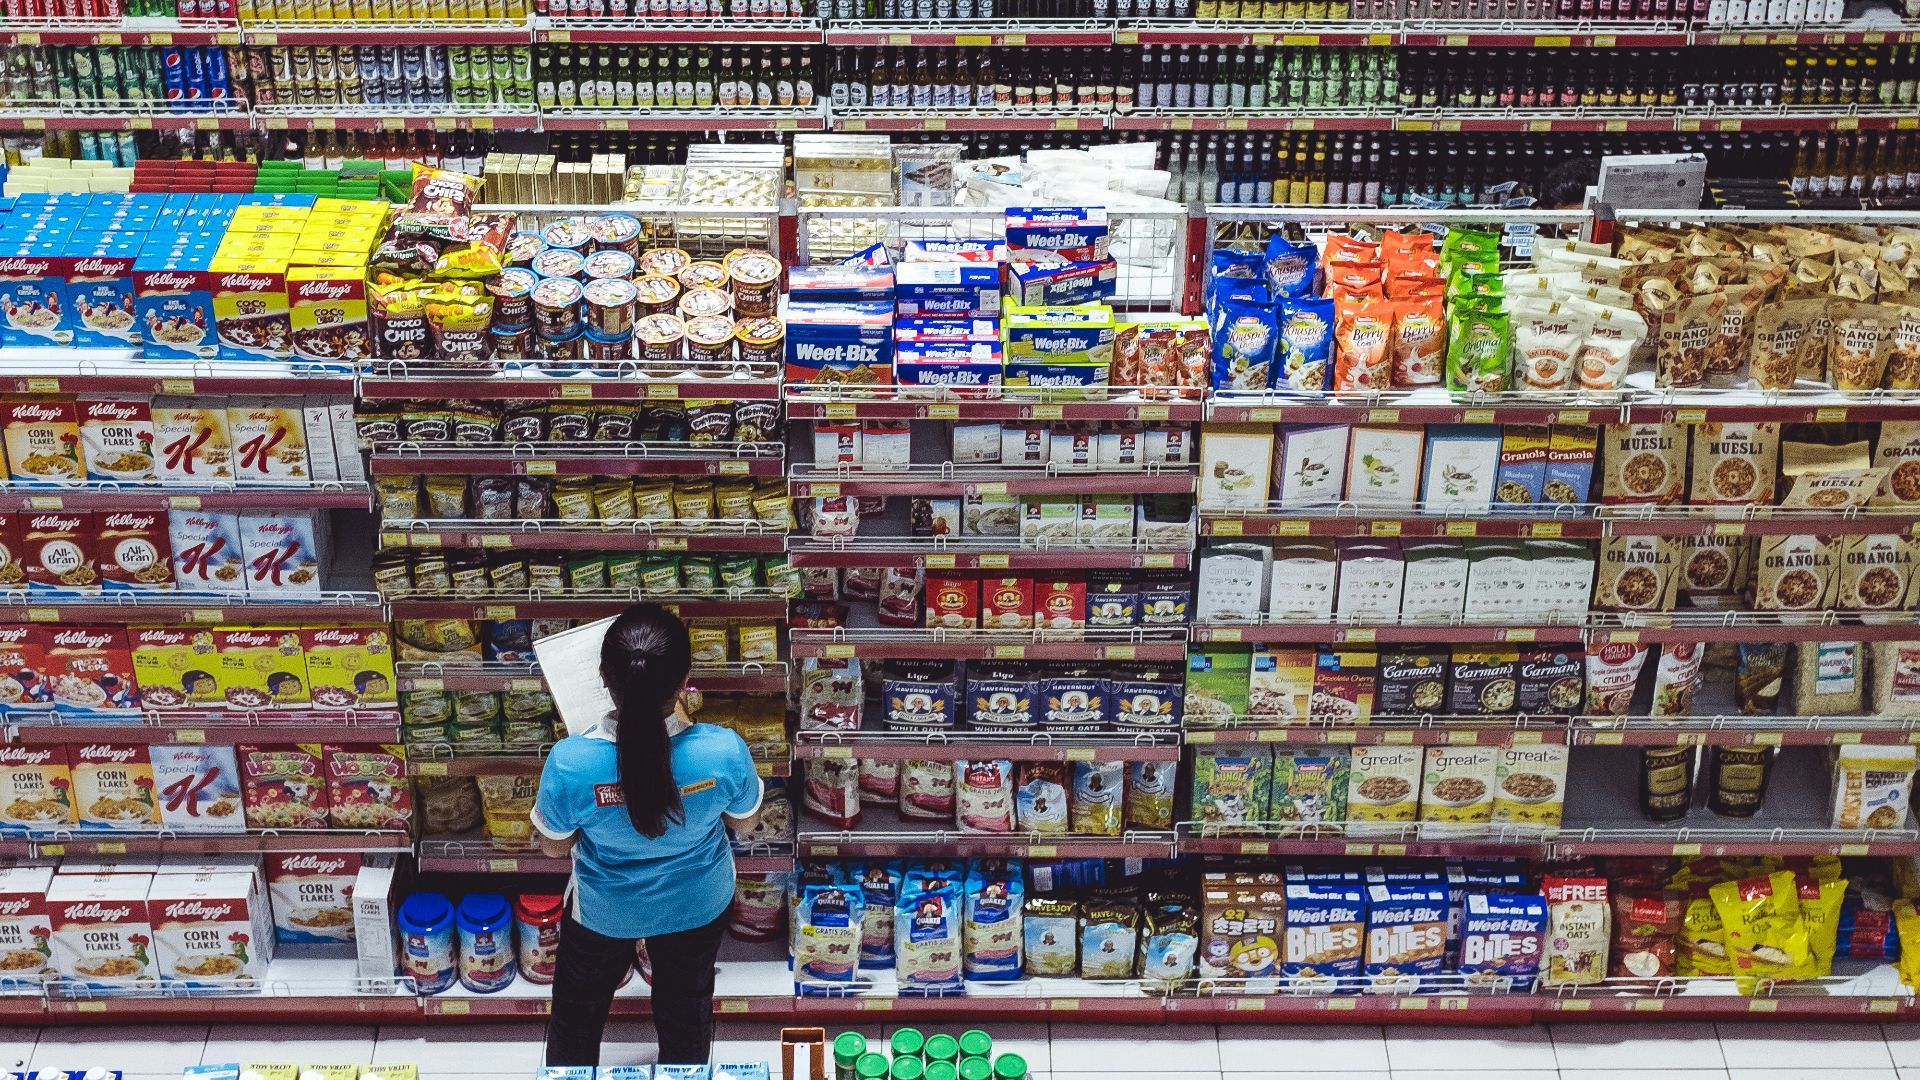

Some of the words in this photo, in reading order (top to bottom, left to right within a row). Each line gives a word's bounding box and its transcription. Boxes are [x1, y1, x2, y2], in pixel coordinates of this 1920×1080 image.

[429, 179, 464, 189] CHOCO
[423, 185, 465, 201] CHIPS
[1026, 234, 1089, 247] Weet-Bix
[925, 242, 987, 252] Weet-Bix
[74, 259, 126, 275] Kellogg's
[1268, 262, 1306, 276] Knusper
[144, 271, 196, 288] Kellogg's
[221, 273, 272, 289] Kellogg's
[299, 281, 353, 297] Kellogg's
[236, 300, 266, 309] COCO
[502, 300, 525, 308] CHOCO
[924, 299, 971, 310] Weet-Bix
[313, 308, 345, 317] COCO
[501, 306, 527, 315] CHIPS
[387, 318, 422, 328] CHOCO
[384, 328, 426, 342] CHIPS
[443, 332, 477, 340] CHOCO
[1284, 324, 1326, 336] Knusper
[1352, 329, 1384, 343] Berry
[1403, 325, 1435, 340] Berry
[1834, 328, 1892, 342] GRANOLA
[1228, 330, 1268, 343] Knusper
[441, 338, 483, 352] CHIPS
[1034, 337, 1088, 350] Weet-Bix
[1462, 337, 1502, 352] Original
[1846, 340, 1875, 350] BITES
[796, 344, 880, 361] Weet-Bix
[918, 371, 982, 384] Weet-Bix
[1030, 374, 1084, 386] Weet-Bix
[12, 404, 63, 419] Kellogg's
[88, 402, 138, 417] Kellogg's
[173, 412, 205, 422] Kellogg's
[248, 411, 279, 422] Kellogg's
[27, 429, 55, 438] CORN
[101, 427, 134, 438] CORN
[159, 423, 193, 434] Special
[234, 423, 268, 433] Special
[29, 437, 56, 446] FLAKES
[103, 436, 135, 447] FLAKES
[1620, 437, 1673, 451] MUESLI
[163, 427, 212, 475] K
[238, 427, 287, 474] K
[1709, 442, 1763, 455] MUESLI
[1502, 448, 1546, 463] Granola
[1548, 448, 1593, 462] Granola
[1809, 479, 1865, 488] MUESLI
[678, 500, 707, 508] ENERGEN
[31, 514, 81, 530] Kellogg's
[105, 514, 155, 528] Kellogg's
[185, 517, 220, 529] Kellogg's
[258, 524, 295, 535] Kellogg's
[177, 532, 209, 542] Special
[249, 539, 284, 549] Special
[53, 547, 72, 558] All-
[127, 545, 146, 556] All-
[1847, 549, 1912, 564] GRANOLA
[48, 554, 76, 566] Bran
[122, 553, 150, 563] Bran
[180, 537, 225, 581] K
[1607, 550, 1671, 564] GRANOLA
[1765, 554, 1830, 567] GRANOLA
[251, 541, 300, 586] K
[492, 563, 522, 576] ENERGEN
[612, 563, 639, 573] ENERGEN
[574, 564, 602, 576] ENERGEN
[646, 569, 674, 580] ENERGEN
[1207, 563, 1255, 577] Granola
[54, 630, 112, 648] Kellogg's
[139, 630, 185, 643] Kellogg's
[226, 632, 271, 645] Kellogg's
[314, 630, 359, 643] Kellogg's
[693, 632, 723, 640] ENERGEN
[743, 632, 774, 640] ENERGEN
[992, 671, 1015, 681] Ligo
[1383, 663, 1442, 678] Carman's
[1454, 663, 1513, 678] Carman's
[1522, 662, 1580, 678] Carman's
[1677, 667, 1698, 680] crunch
[907, 672, 930, 681] Ligo
[1603, 673, 1631, 684] crunch
[80, 745, 136, 762] Kellogg's
[172, 752, 210, 763] Kellogg's
[1505, 750, 1549, 767] great
[1720, 752, 1766, 763] GRANOLA
[1360, 753, 1404, 771] great
[1436, 753, 1478, 772] great
[96, 770, 128, 780] CORN
[158, 763, 200, 775] Special
[12, 772, 43, 783] CORN
[97, 778, 129, 788] FLAKES
[13, 781, 45, 790] FLAKES
[163, 766, 220, 817] K
[281, 856, 346, 873] Kellogg's
[298, 884, 334, 895] CORN
[1562, 885, 1607, 900] FREE
[300, 893, 335, 902] FLAKES
[817, 898, 844, 906] QUAKER
[64, 903, 131, 922] Kellogg's
[165, 902, 232, 920] Kellogg's
[1224, 908, 1246, 920] 오곡
[1287, 907, 1357, 923] Weet-Bix
[1371, 907, 1442, 924] Weet-Bix
[1467, 919, 1539, 932] Weet-Bix
[1559, 922, 1596, 930] INSTANT
[83, 932, 119, 943] CORN
[183, 930, 219, 942] CORN
[1567, 930, 1590, 939] OATS
[85, 941, 122, 951] FLAKES
[185, 939, 222, 950] FLAKES
